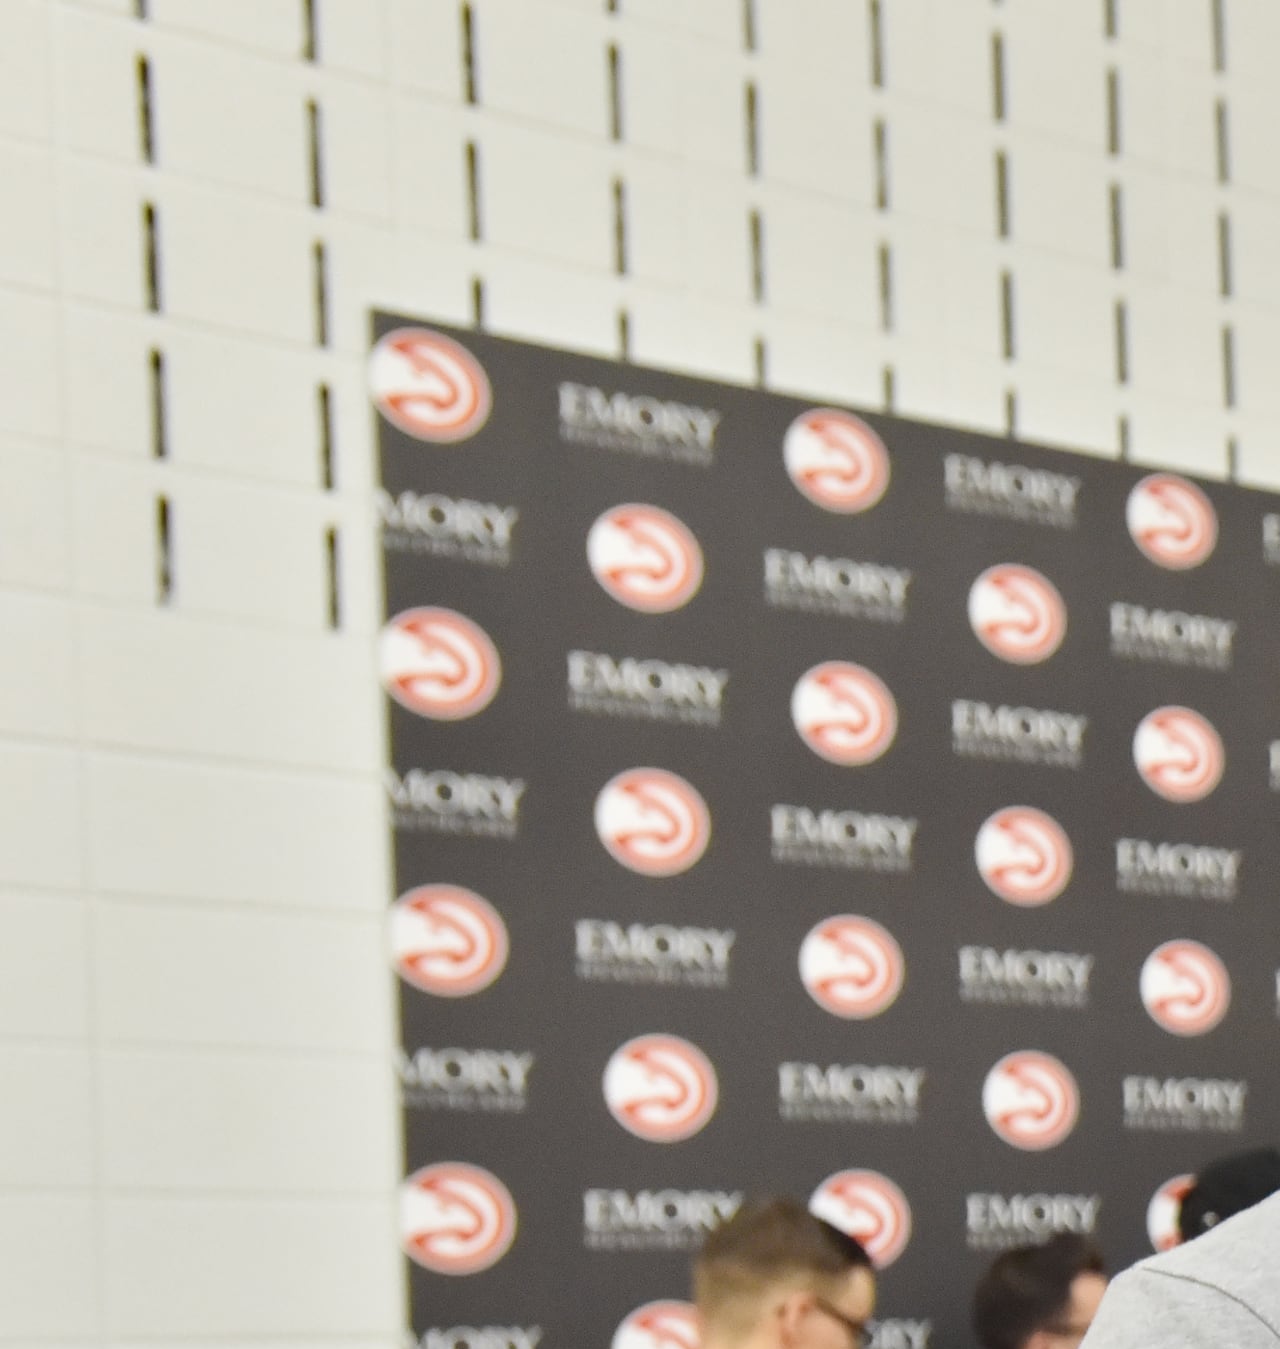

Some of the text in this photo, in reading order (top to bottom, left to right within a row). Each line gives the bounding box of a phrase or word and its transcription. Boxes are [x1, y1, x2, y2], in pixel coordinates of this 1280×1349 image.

[559, 381, 720, 449] EMORY
[944, 452, 1081, 513] EMORY
[376, 488, 518, 547] MORY
[764, 547, 911, 606] EMORY
[1110, 601, 1236, 655] EMORY
[567, 649, 730, 708] EMORY
[952, 700, 1087, 753] EMORY
[387, 768, 525, 820] MORY
[771, 803, 918, 857] EMORY
[1116, 838, 1242, 885] EMORY
[575, 919, 736, 971] EMORY
[958, 945, 1094, 990] EMORY
[394, 1047, 534, 1094] MORY
[778, 1062, 926, 1109] EMORY
[1123, 1075, 1247, 1117] EMORY
[966, 1192, 1099, 1235] EMORY
